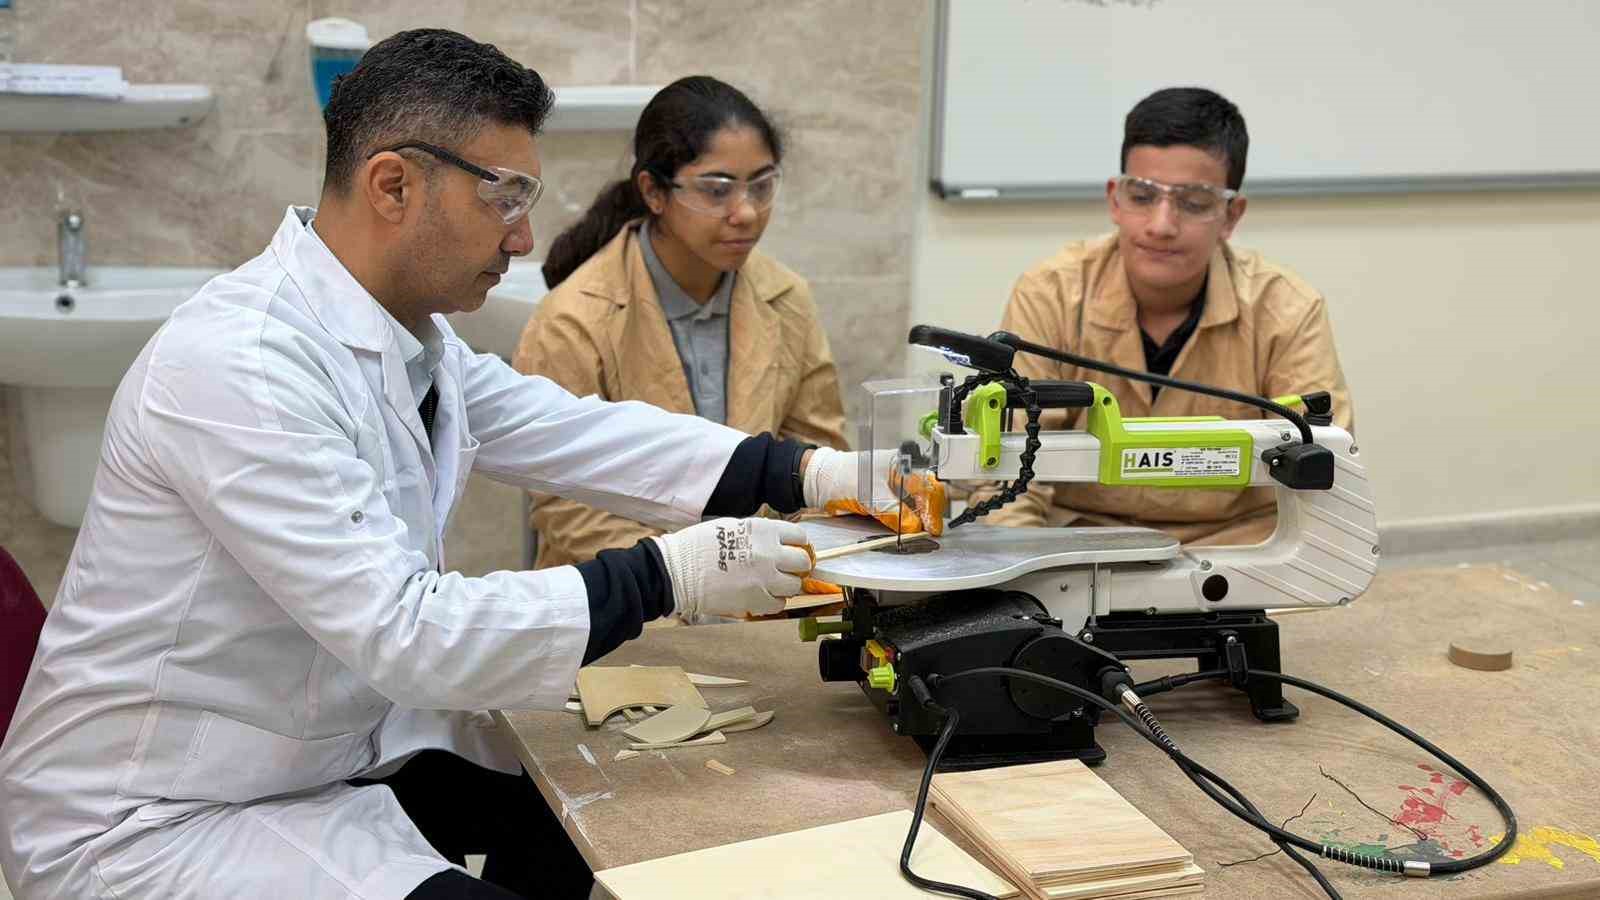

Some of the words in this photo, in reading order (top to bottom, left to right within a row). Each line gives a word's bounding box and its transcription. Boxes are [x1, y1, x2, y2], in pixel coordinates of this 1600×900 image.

[1124, 452, 1173, 468] HAIS
[716, 526, 728, 572] Beybi
[727, 530, 736, 561] PN3
